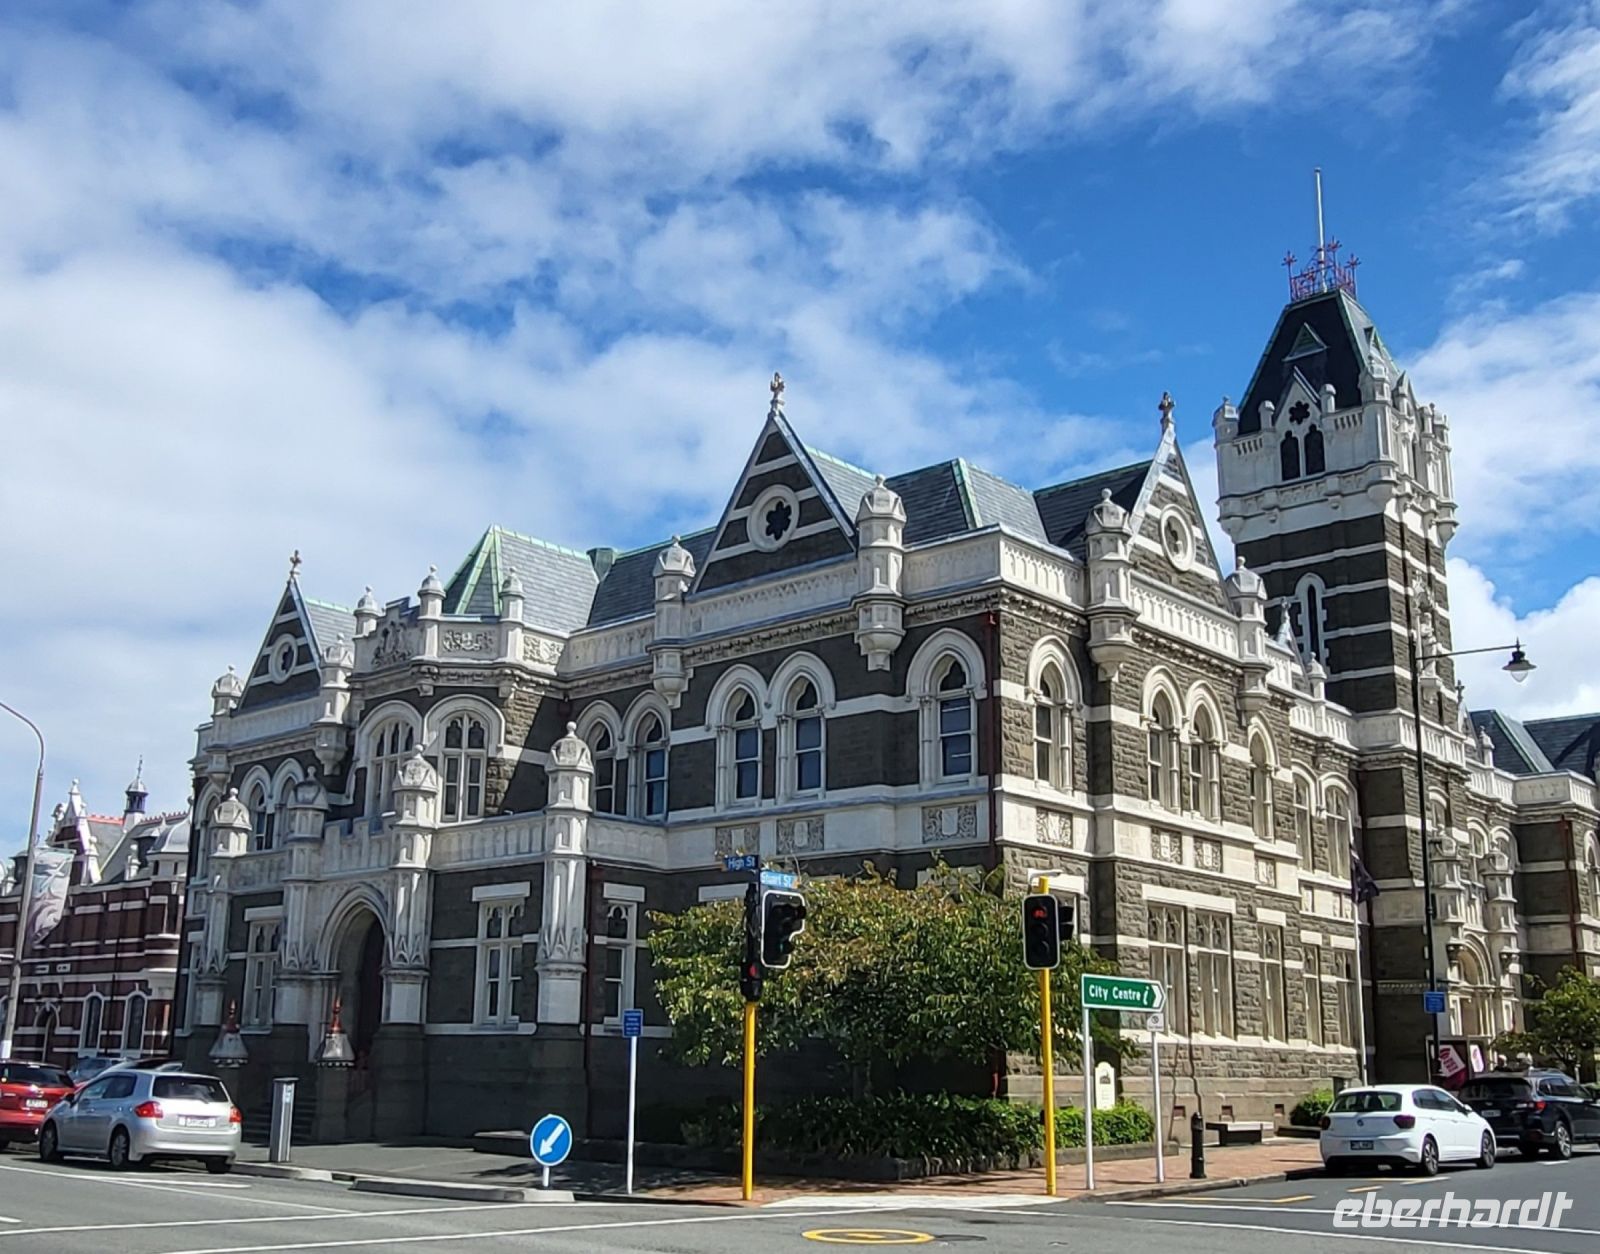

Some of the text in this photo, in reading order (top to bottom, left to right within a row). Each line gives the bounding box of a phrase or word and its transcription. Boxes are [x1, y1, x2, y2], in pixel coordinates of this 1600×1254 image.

[746, 855, 756, 867] St
[1088, 984, 1108, 1001] City
[1112, 986, 1141, 1001] Centre
